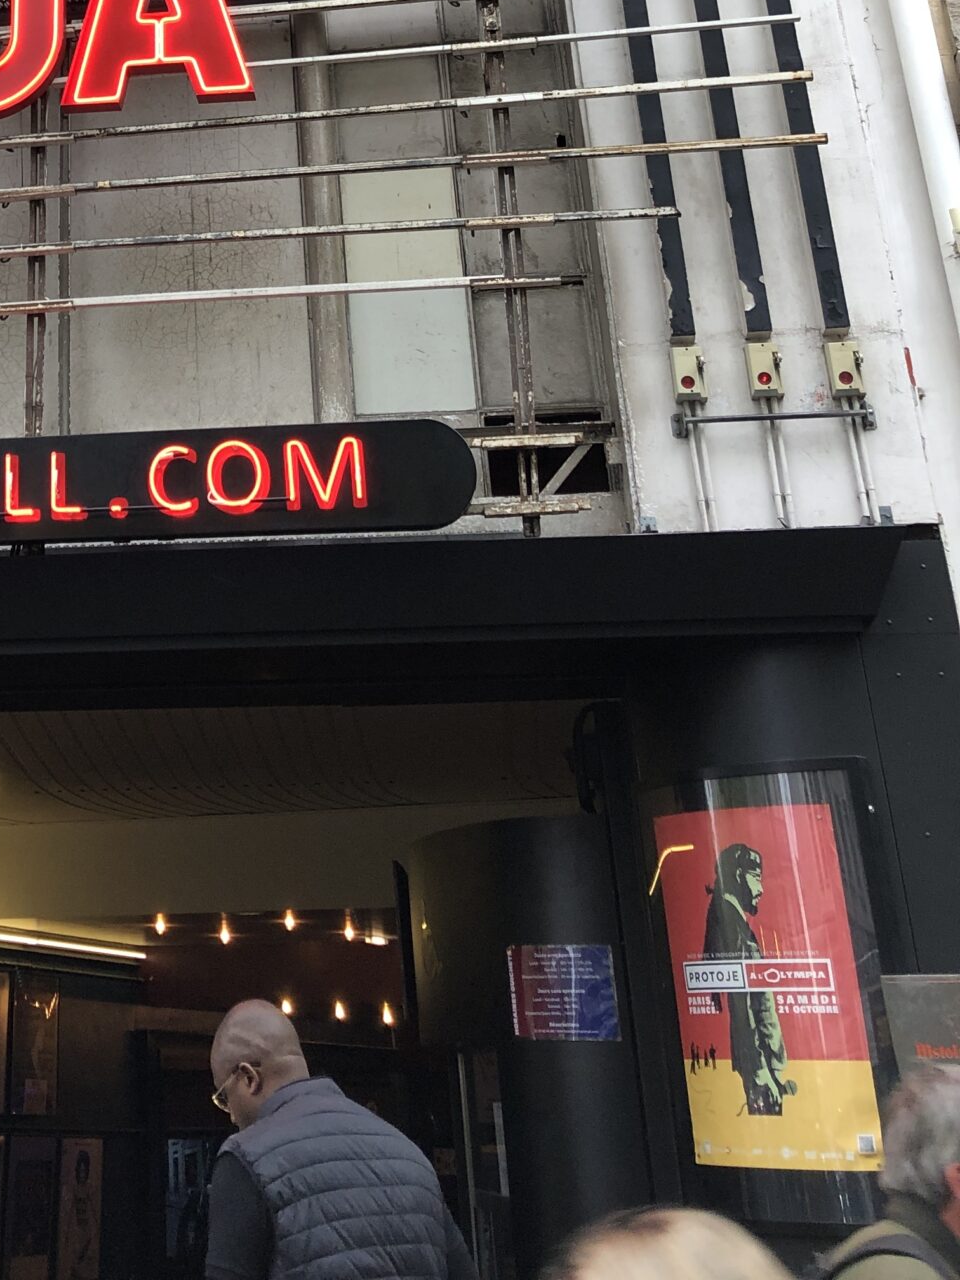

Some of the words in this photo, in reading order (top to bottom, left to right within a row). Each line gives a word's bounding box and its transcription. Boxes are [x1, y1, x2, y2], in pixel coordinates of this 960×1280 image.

[689, 970, 740, 983] PROTOJE
[776, 994, 838, 1005] SAMEDI
[778, 1006, 790, 1014] 21
[792, 1005, 840, 1014] OCTOBRE
